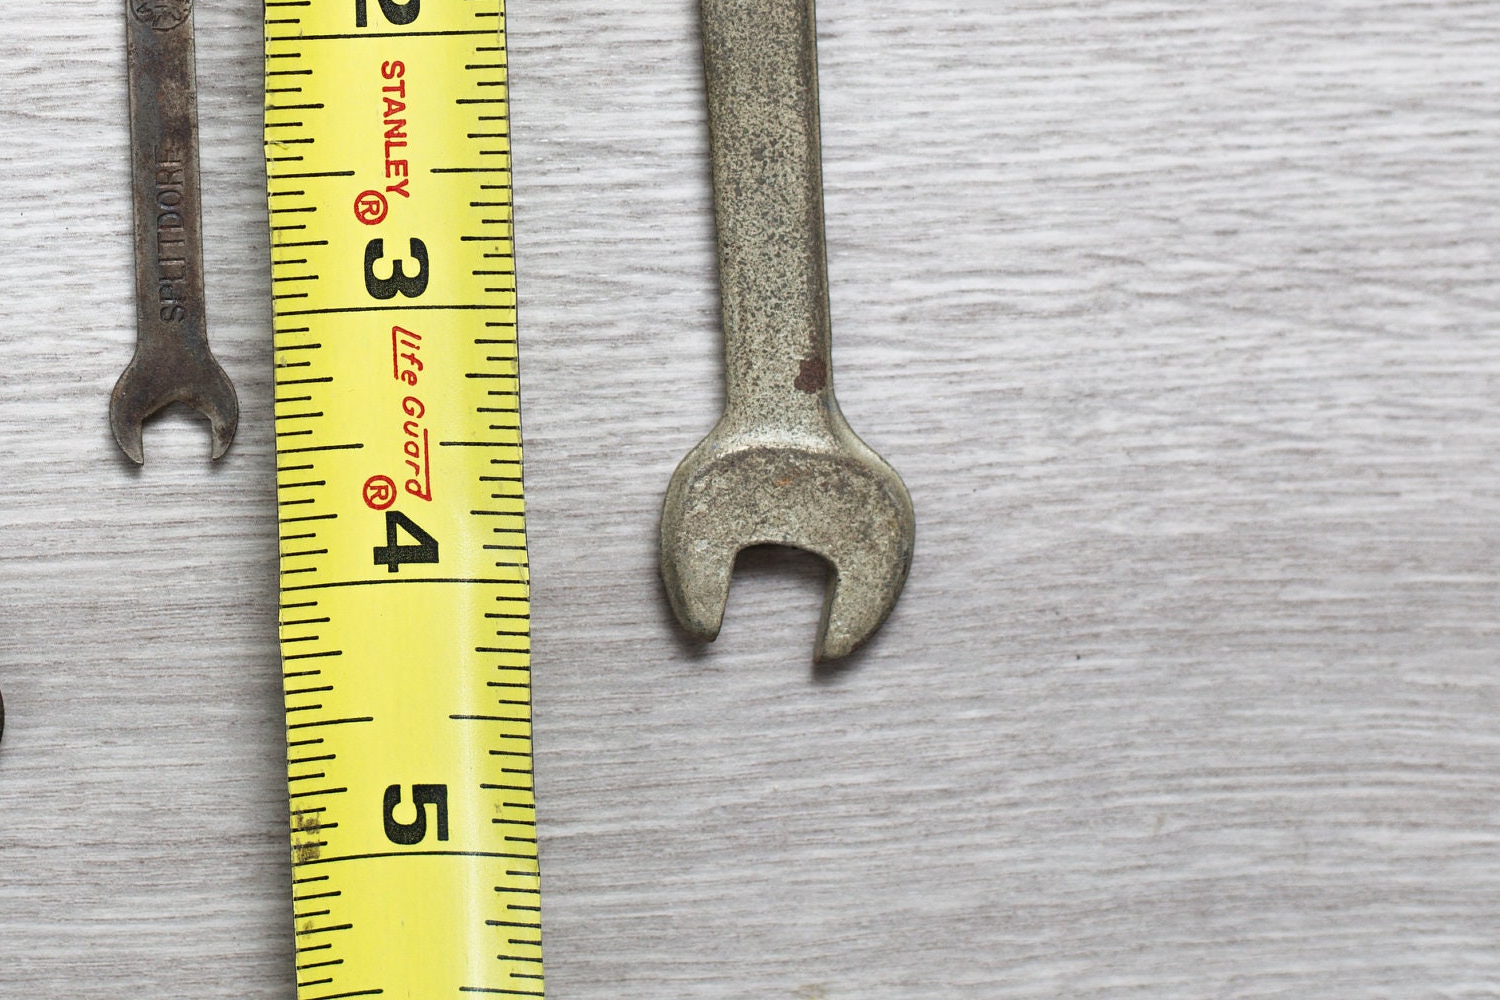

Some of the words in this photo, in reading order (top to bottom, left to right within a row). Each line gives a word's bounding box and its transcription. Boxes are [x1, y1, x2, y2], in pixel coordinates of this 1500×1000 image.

[380, 60, 411, 200] STANLEY
[363, 237, 430, 300] 3
[401, 395, 433, 503] Guard
[373, 510, 440, 573] 4
[382, 783, 449, 846] 5
